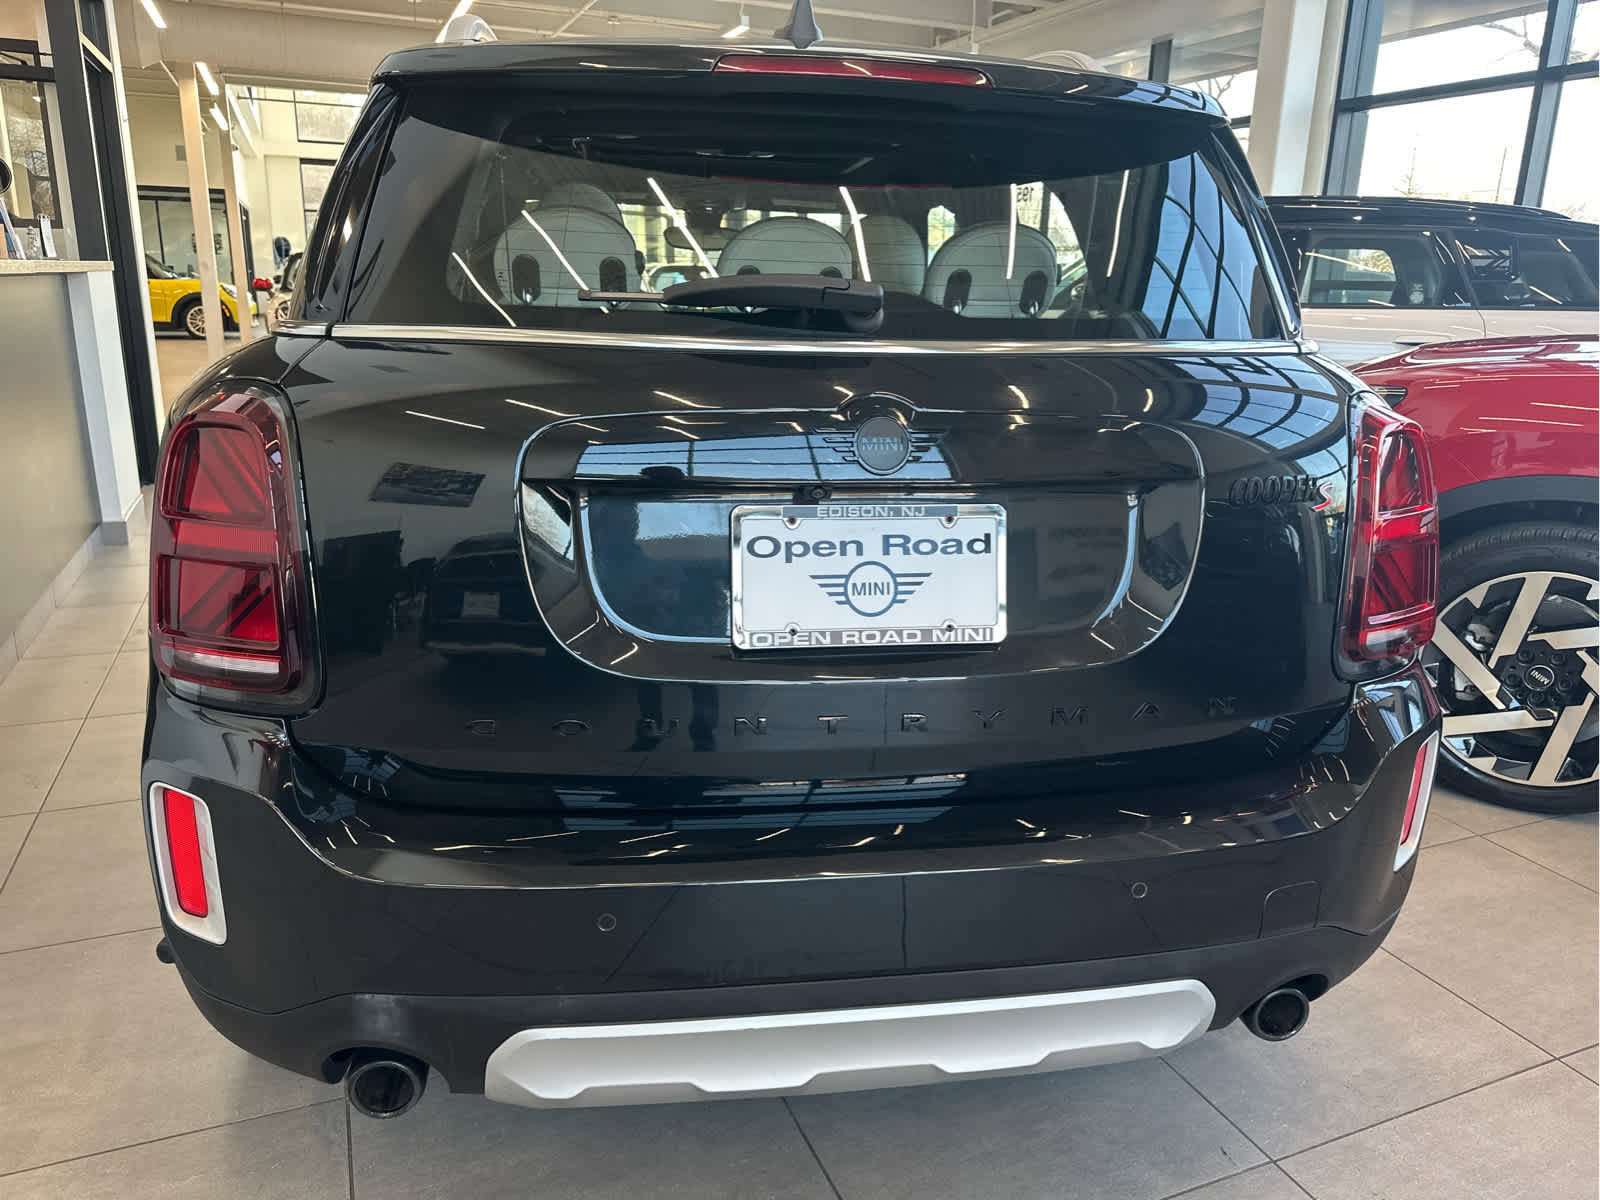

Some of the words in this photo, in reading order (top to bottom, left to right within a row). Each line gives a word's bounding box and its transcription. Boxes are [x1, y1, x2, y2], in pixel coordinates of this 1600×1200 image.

[861, 437, 905, 451] MINI
[1311, 482, 1334, 512] S
[816, 506, 894, 518] EDISON,
[901, 506, 926, 517] NJ
[746, 535, 864, 564] Open
[881, 532, 992, 557] Road
[851, 581, 891, 597] MINI
[751, 630, 832, 648] OPEN
[841, 628, 921, 645] ROAD
[931, 627, 993, 643] MINI
[1530, 669, 1551, 686] MINI
